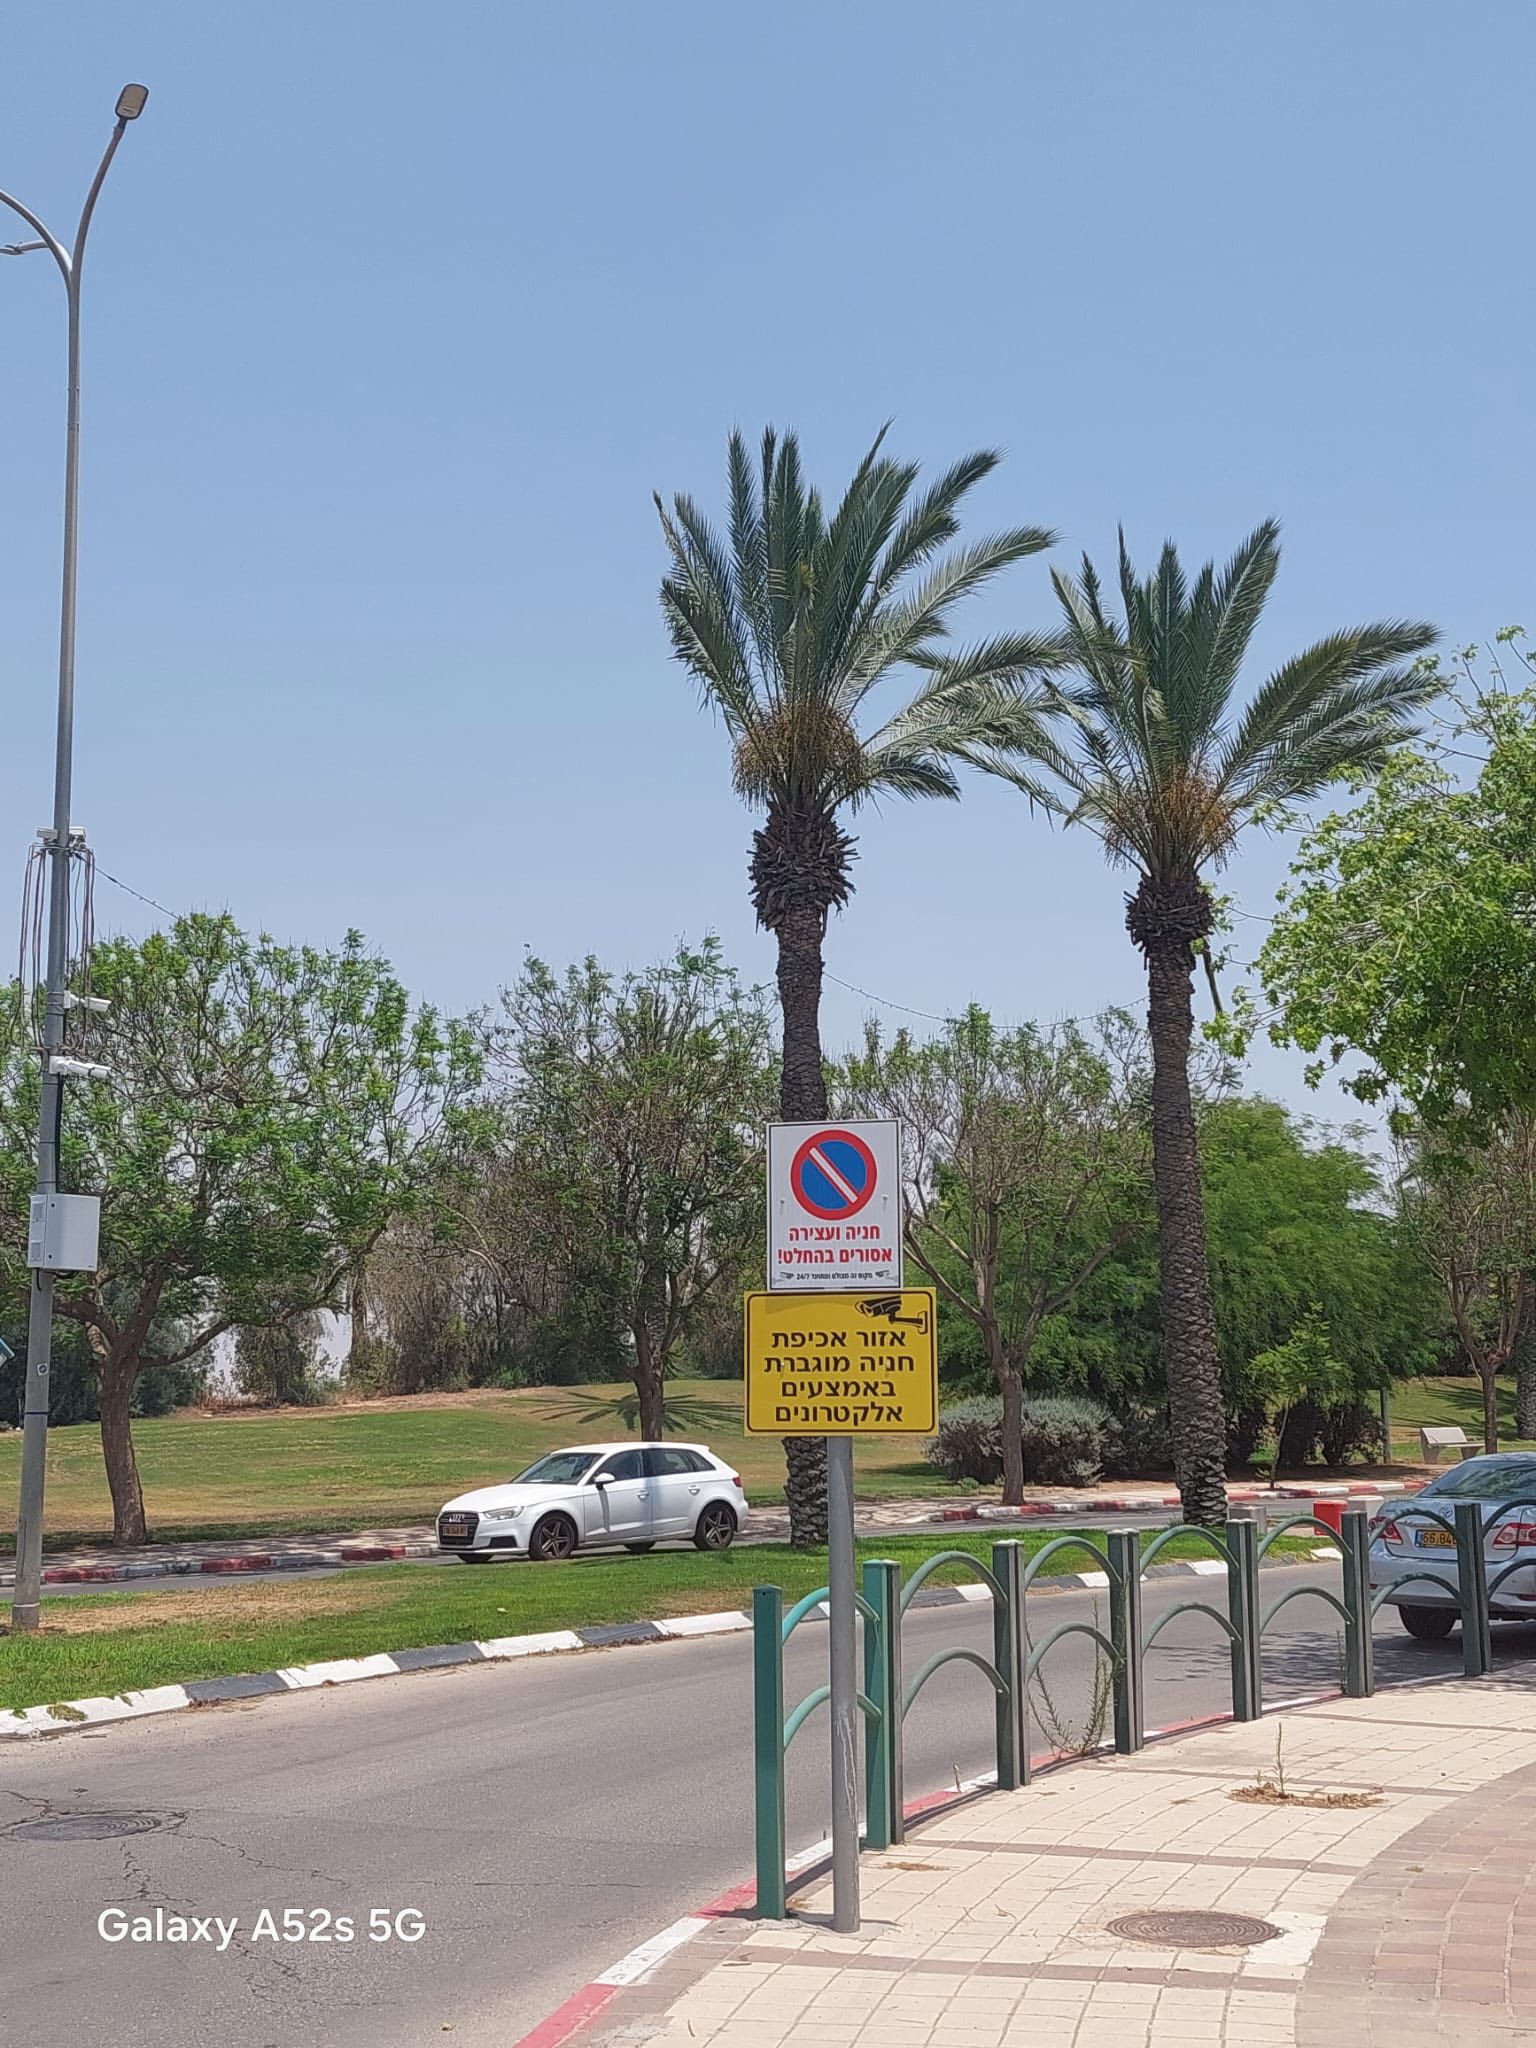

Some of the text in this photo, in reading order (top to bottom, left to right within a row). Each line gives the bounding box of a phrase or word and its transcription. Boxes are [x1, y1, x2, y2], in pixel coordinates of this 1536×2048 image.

[789, 1225, 881, 1242] חניה ועצירה
[777, 1247, 893, 1265] אסורים בהחלט!
[771, 1331, 906, 1348] אזור אכיפת
[763, 1355, 915, 1373] חניה מוגברת
[781, 1381, 897, 1399] באמצעים
[775, 1401, 903, 1426] אלקטרונים
